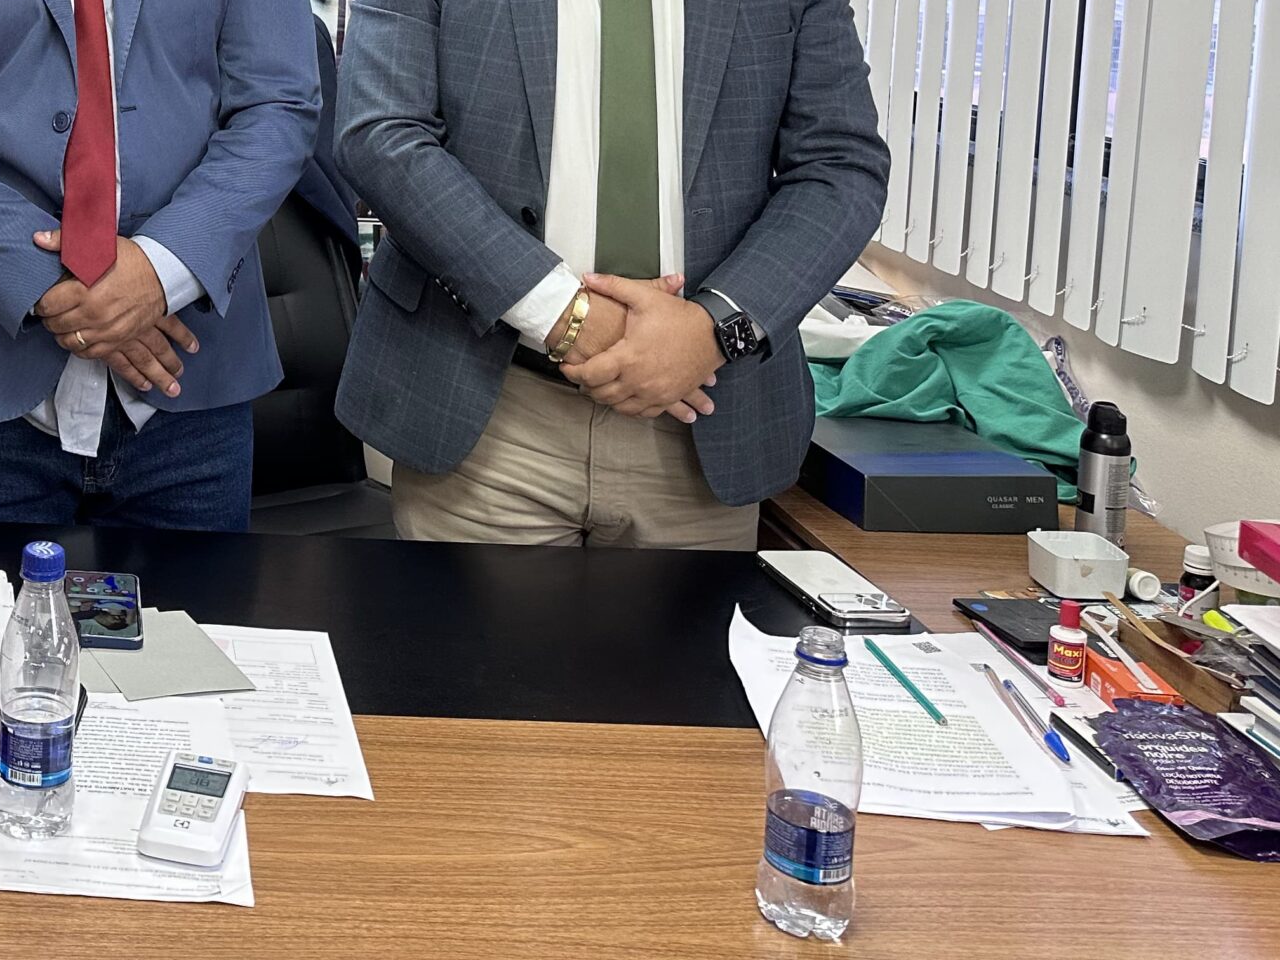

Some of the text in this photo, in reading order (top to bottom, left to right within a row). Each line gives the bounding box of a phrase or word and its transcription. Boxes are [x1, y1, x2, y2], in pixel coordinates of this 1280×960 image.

[987, 496, 1044, 504] QUASAR MEN
[1053, 643, 1083, 658] Maxi
